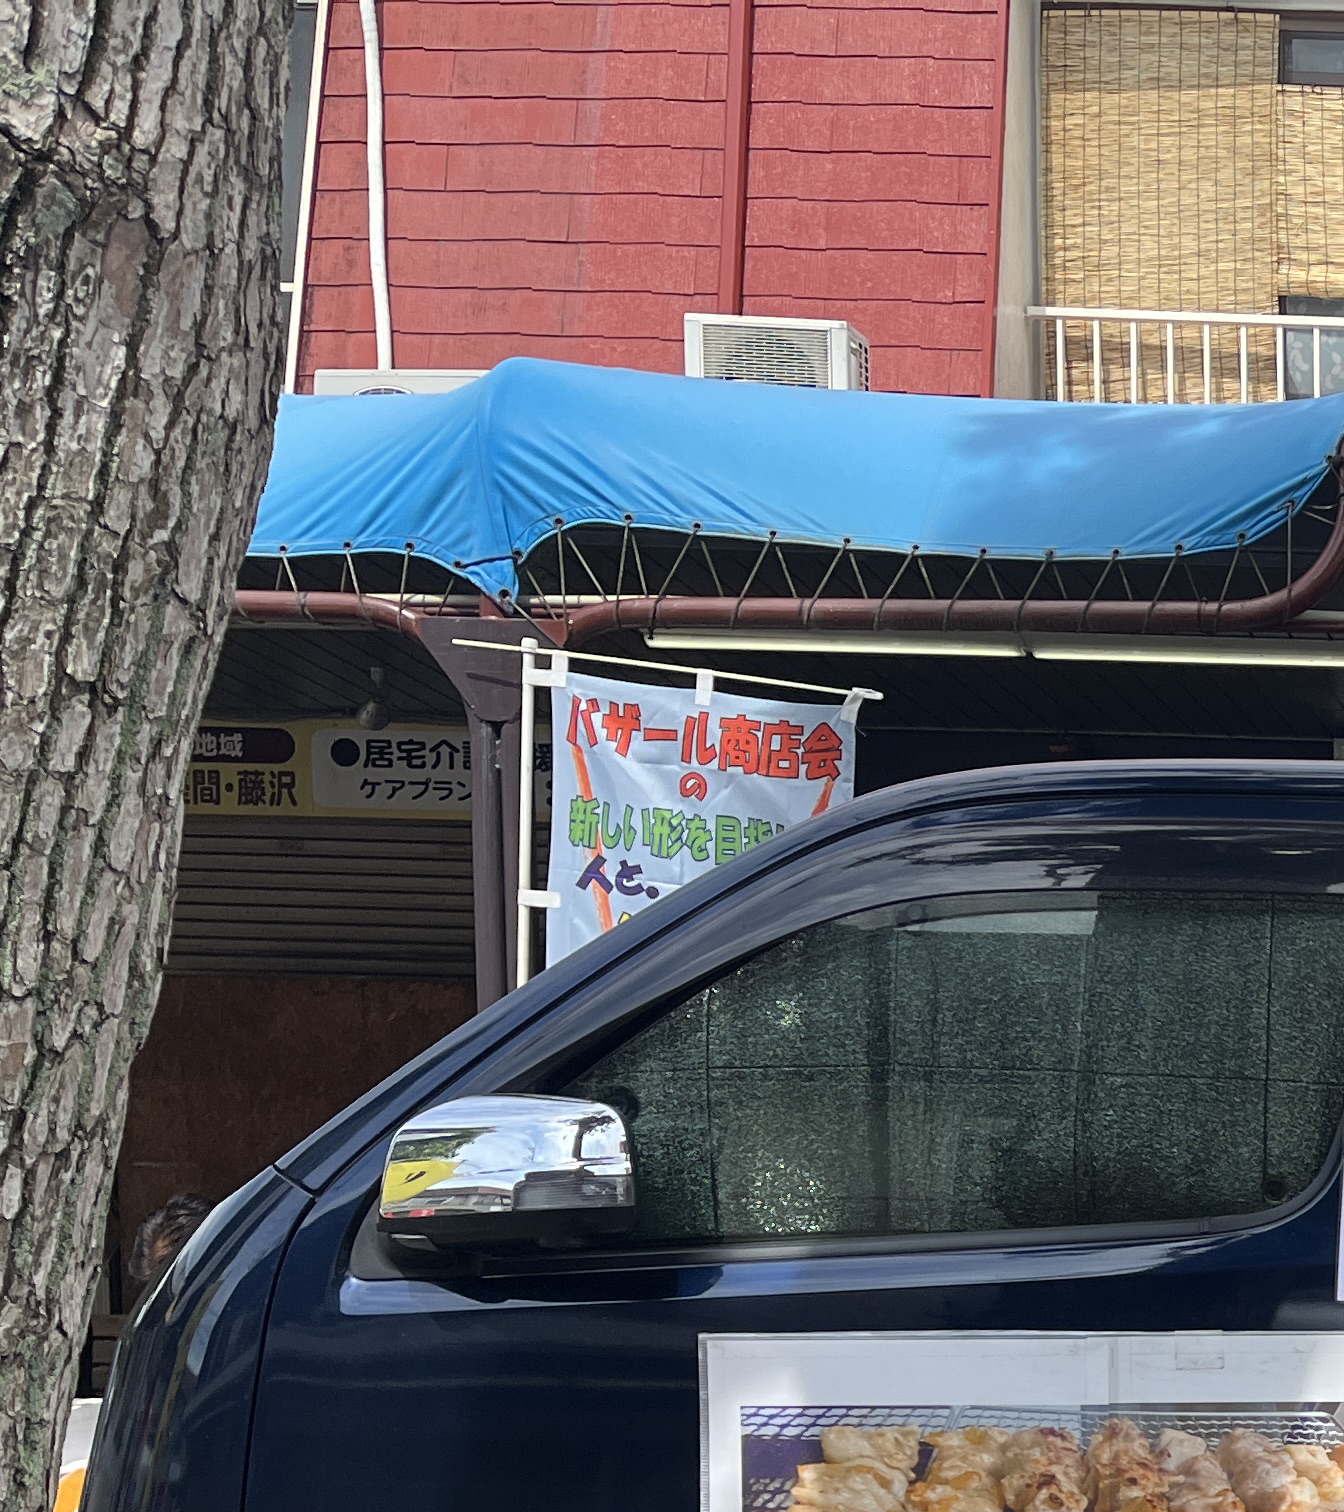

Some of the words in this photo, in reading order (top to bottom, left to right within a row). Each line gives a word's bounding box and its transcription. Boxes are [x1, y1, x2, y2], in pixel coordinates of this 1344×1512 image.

[566, 694, 843, 781] バザール商店会
[183, 769, 298, 807] 間・藤沢
[679, 771, 708, 801] の
[569, 795, 785, 866] 新しい形を目指
